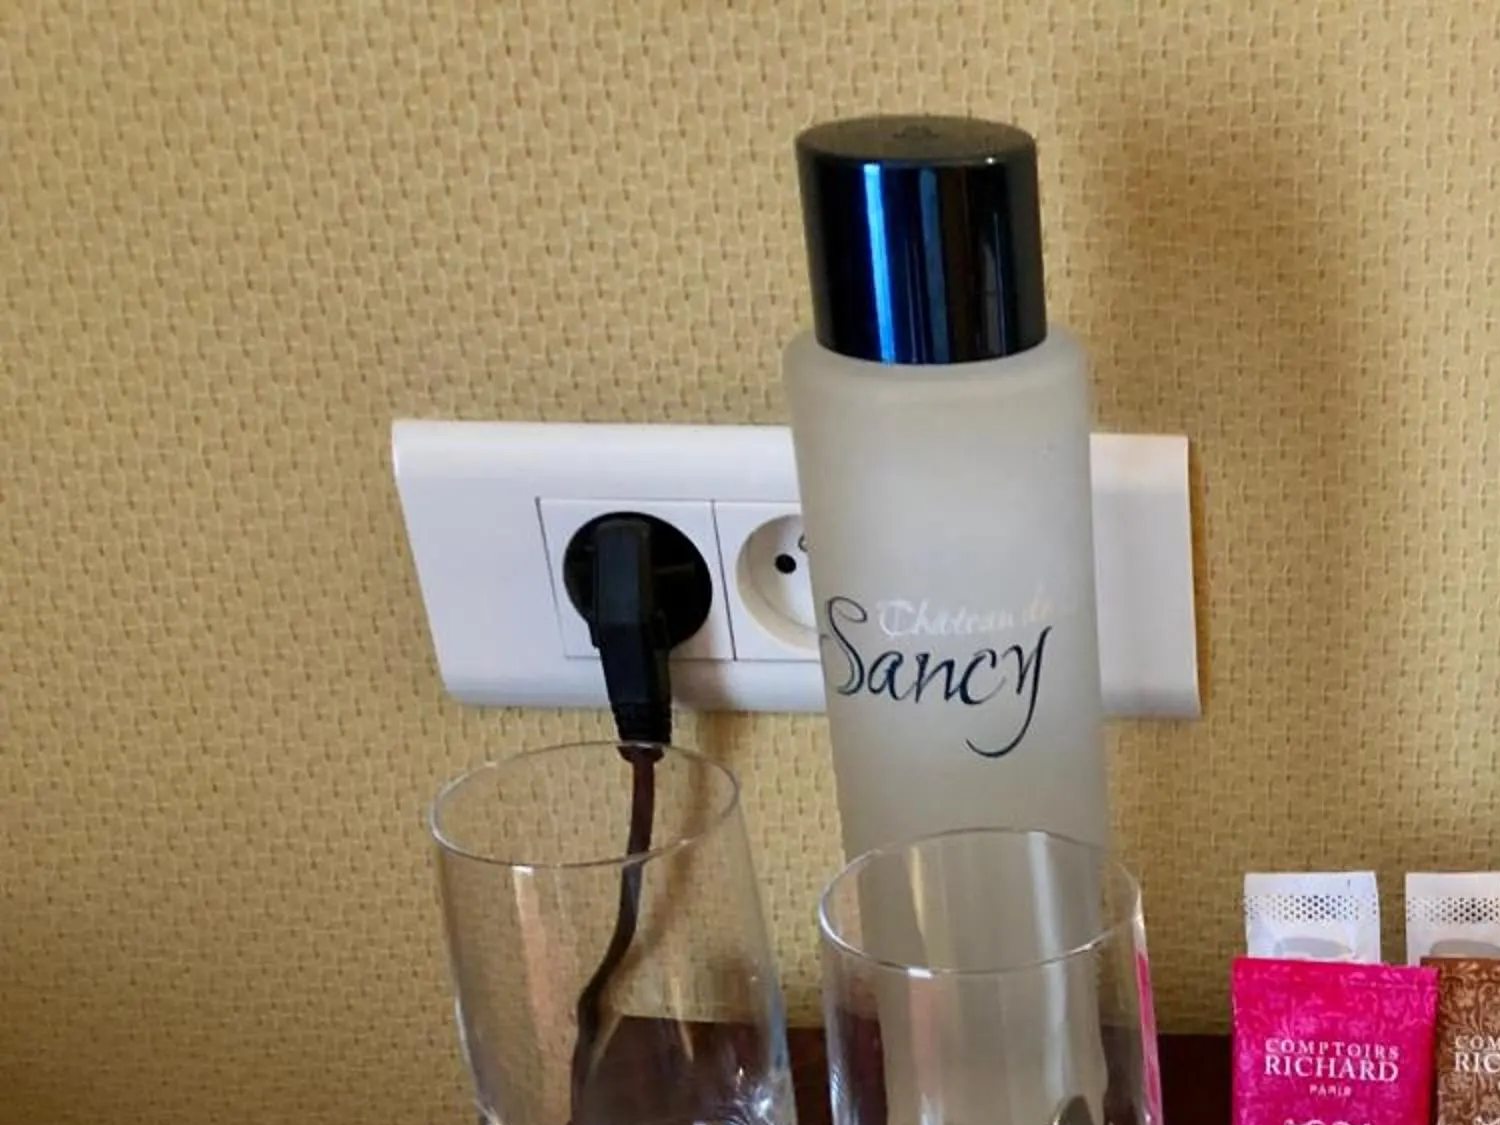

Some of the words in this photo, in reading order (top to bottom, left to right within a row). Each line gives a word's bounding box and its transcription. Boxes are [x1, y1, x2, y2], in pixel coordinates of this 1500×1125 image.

[826, 596, 1053, 758] Sancy
[1264, 1038, 1400, 1060] COMPTOIRS
[1263, 1055, 1399, 1082] RICHARD
